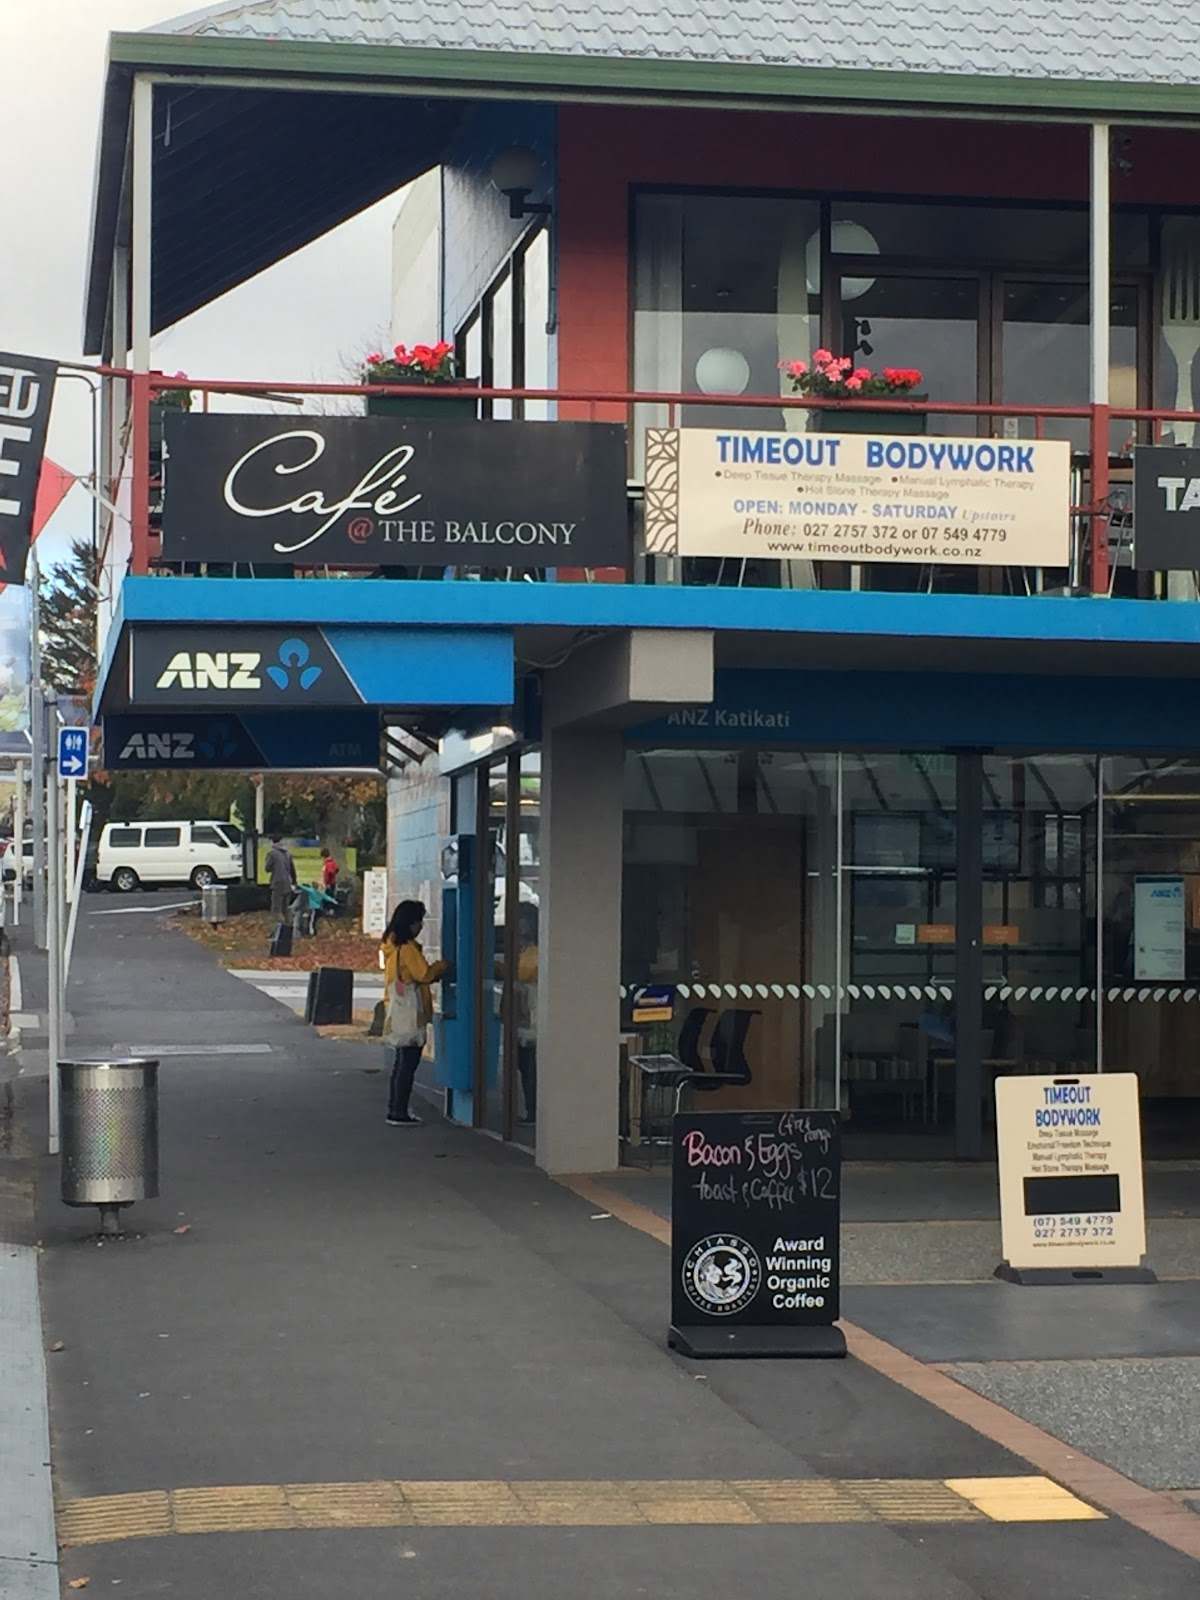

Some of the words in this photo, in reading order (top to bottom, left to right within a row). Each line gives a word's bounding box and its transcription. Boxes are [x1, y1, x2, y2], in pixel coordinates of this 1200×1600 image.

[716, 435, 840, 466] TIMEOUT
[866, 440, 1034, 473] BODYWORK
[723, 470, 752, 481] Deep
[755, 470, 788, 481] Tissue
[790, 471, 832, 483] Therapy
[835, 473, 882, 486] Massage
[899, 475, 937, 486] Manual
[939, 476, 990, 489] Lymphatic
[994, 478, 1034, 491] Therapy
[223, 430, 422, 553] Café
[805, 485, 823, 495] Hot
[827, 485, 856, 496] Stone
[859, 486, 900, 498] Therapy
[903, 489, 950, 501] Massage
[733, 500, 783, 514] OPEN:
[789, 501, 858, 516] MONDAY
[872, 504, 958, 519] SATURDAY
[348, 517, 374, 544] @
[379, 519, 435, 543] THE
[445, 521, 576, 545] BALCONY
[743, 518, 796, 536] Phone:
[803, 523, 827, 537] 027
[833, 524, 867, 538] 2757
[872, 526, 898, 539] 372
[902, 528, 917, 540] or
[921, 527, 938, 540] 07
[943, 528, 969, 541] 549
[972, 528, 1007, 542] 4779
[768, 542, 982, 557] www.timeoutbodywork.co.nz
[156, 653, 261, 689] ANZ
[667, 710, 708, 725] ANZ
[715, 710, 790, 727] Katikati
[119, 733, 195, 759] ANZ
[329, 744, 361, 757] ATM
[1043, 1086, 1091, 1104] TIMEOUT
[1035, 1108, 1101, 1127] BODYWORK
[682, 1131, 741, 1166] Bacon
[758, 1133, 802, 1180] Eggs
[692, 1171, 738, 1203] toast
[797, 1165, 837, 1199] $12
[1033, 1216, 1056, 1227] (07)
[1086, 1215, 1113, 1225] 4779
[1034, 1229, 1056, 1238] 027
[1060, 1227, 1088, 1238] 2757
[1092, 1227, 1113, 1236] 372
[686, 1237, 757, 1269] CHIASSO
[773, 1236, 825, 1252] Award
[766, 1255, 831, 1272] Winning
[767, 1274, 830, 1292] Organic
[773, 1294, 824, 1309] Coffee
